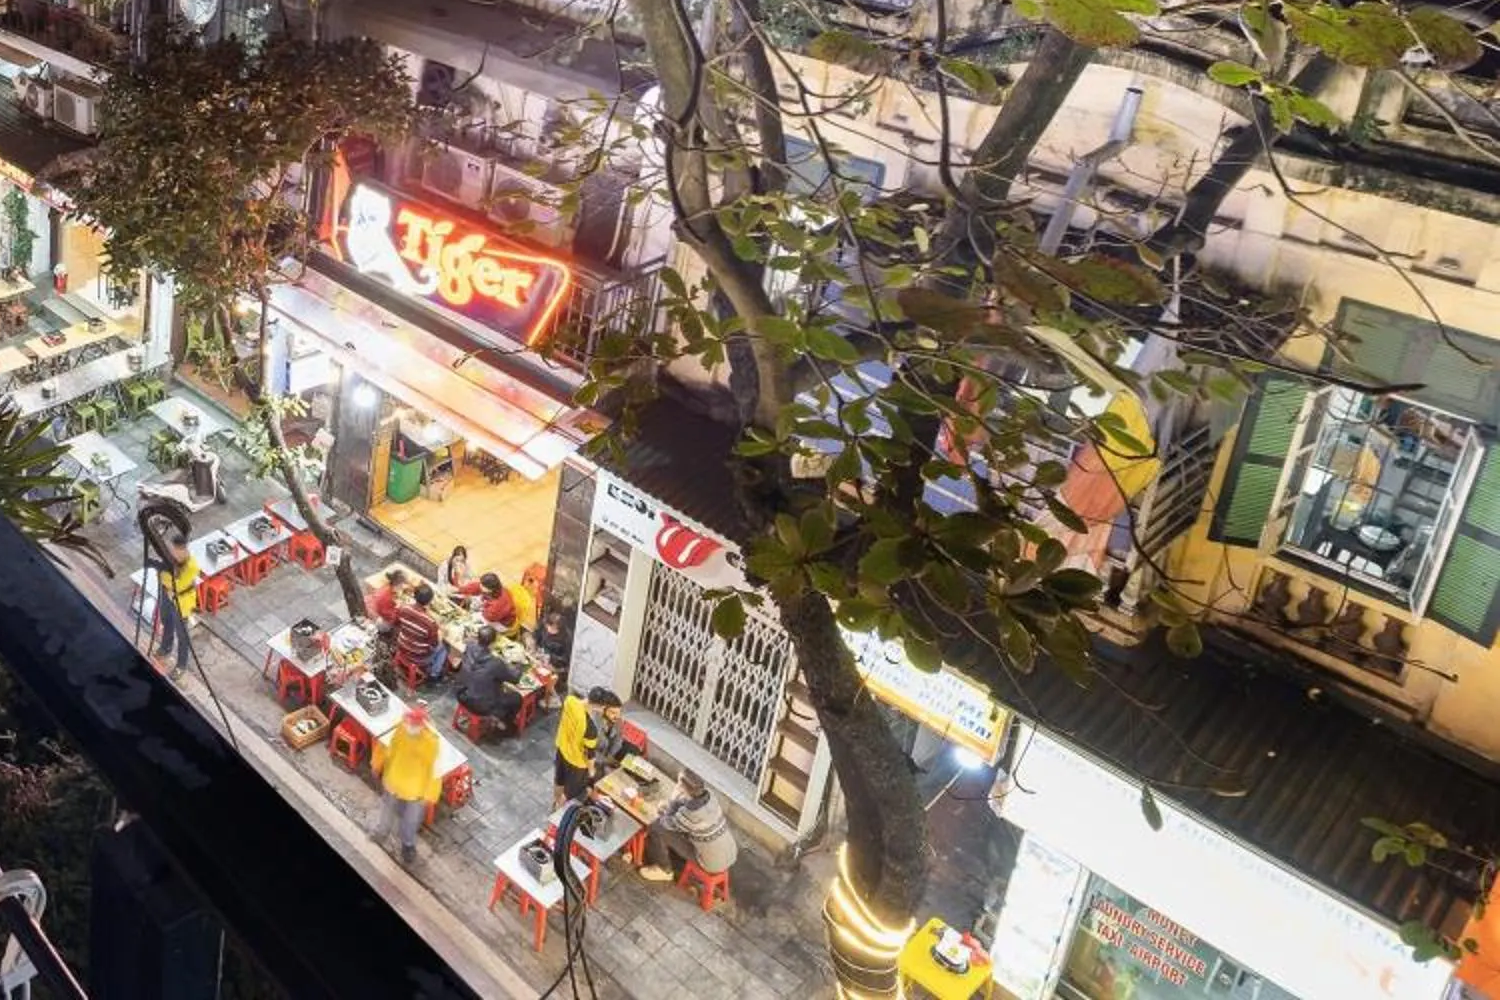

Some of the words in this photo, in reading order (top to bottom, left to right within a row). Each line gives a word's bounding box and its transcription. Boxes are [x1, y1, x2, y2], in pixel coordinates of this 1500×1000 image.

[396, 208, 534, 308] Tiger
[1097, 920, 1124, 947] TAXI
[1130, 943, 1188, 985] AIRPORT
[1149, 930, 1206, 974] SERVICE
